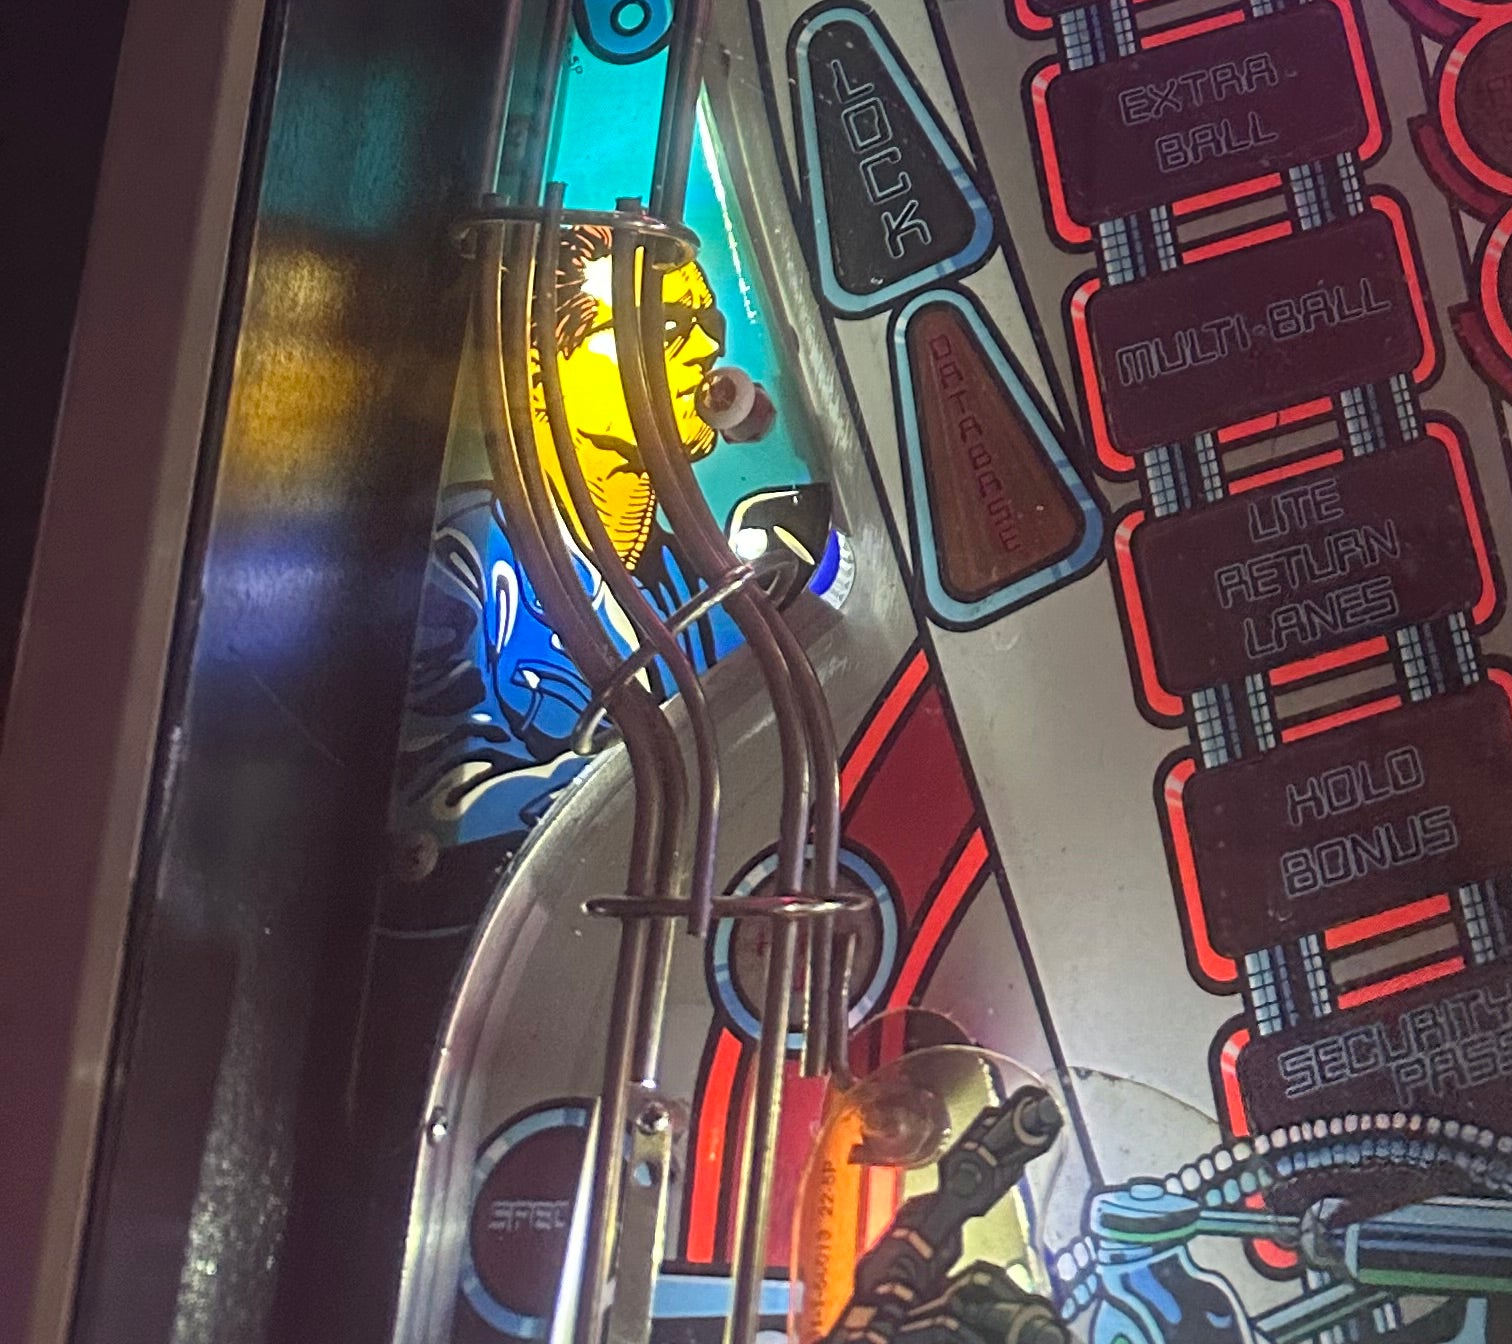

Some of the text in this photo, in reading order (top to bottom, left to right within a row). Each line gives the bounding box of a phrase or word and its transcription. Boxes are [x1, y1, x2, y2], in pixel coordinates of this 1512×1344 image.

[829, 59, 934, 260] LOCK
[1153, 112, 1279, 175] BALL
[927, 333, 1022, 553] DATABASE
[1246, 476, 1344, 544] LITE
[1213, 518, 1402, 610] RETURN
[1241, 575, 1401, 661] LANES
[1283, 743, 1426, 828] HOLD
[1281, 804, 1460, 897] BONUS
